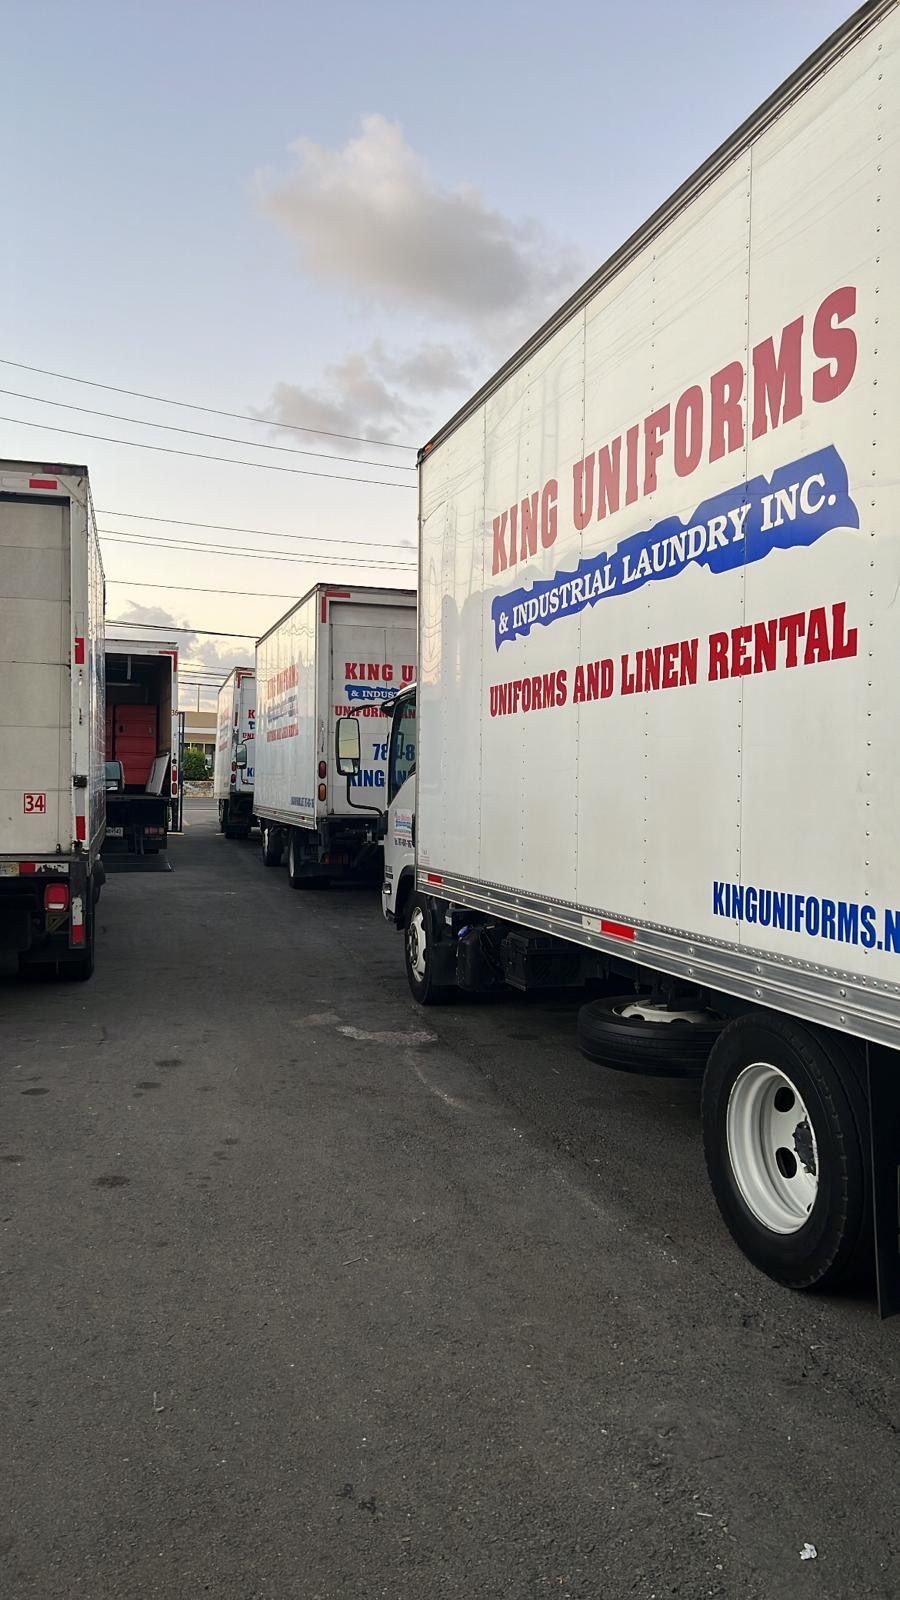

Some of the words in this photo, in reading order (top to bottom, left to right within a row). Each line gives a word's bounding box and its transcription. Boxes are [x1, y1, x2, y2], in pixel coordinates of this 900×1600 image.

[492, 479, 558, 576] KING
[573, 287, 858, 530] UNIFORMS
[498, 612, 509, 634] &
[513, 564, 617, 628] INDUSTRIAL
[622, 503, 752, 584] LAUNDRY
[760, 473, 837, 532] INC.
[345, 662, 393, 681] KING
[490, 670, 567, 717] UNIFORMS
[573, 659, 614, 703] AND
[621, 638, 698, 695] LINEN
[708, 602, 858, 681] RENTAL
[25, 795, 45, 812] 34
